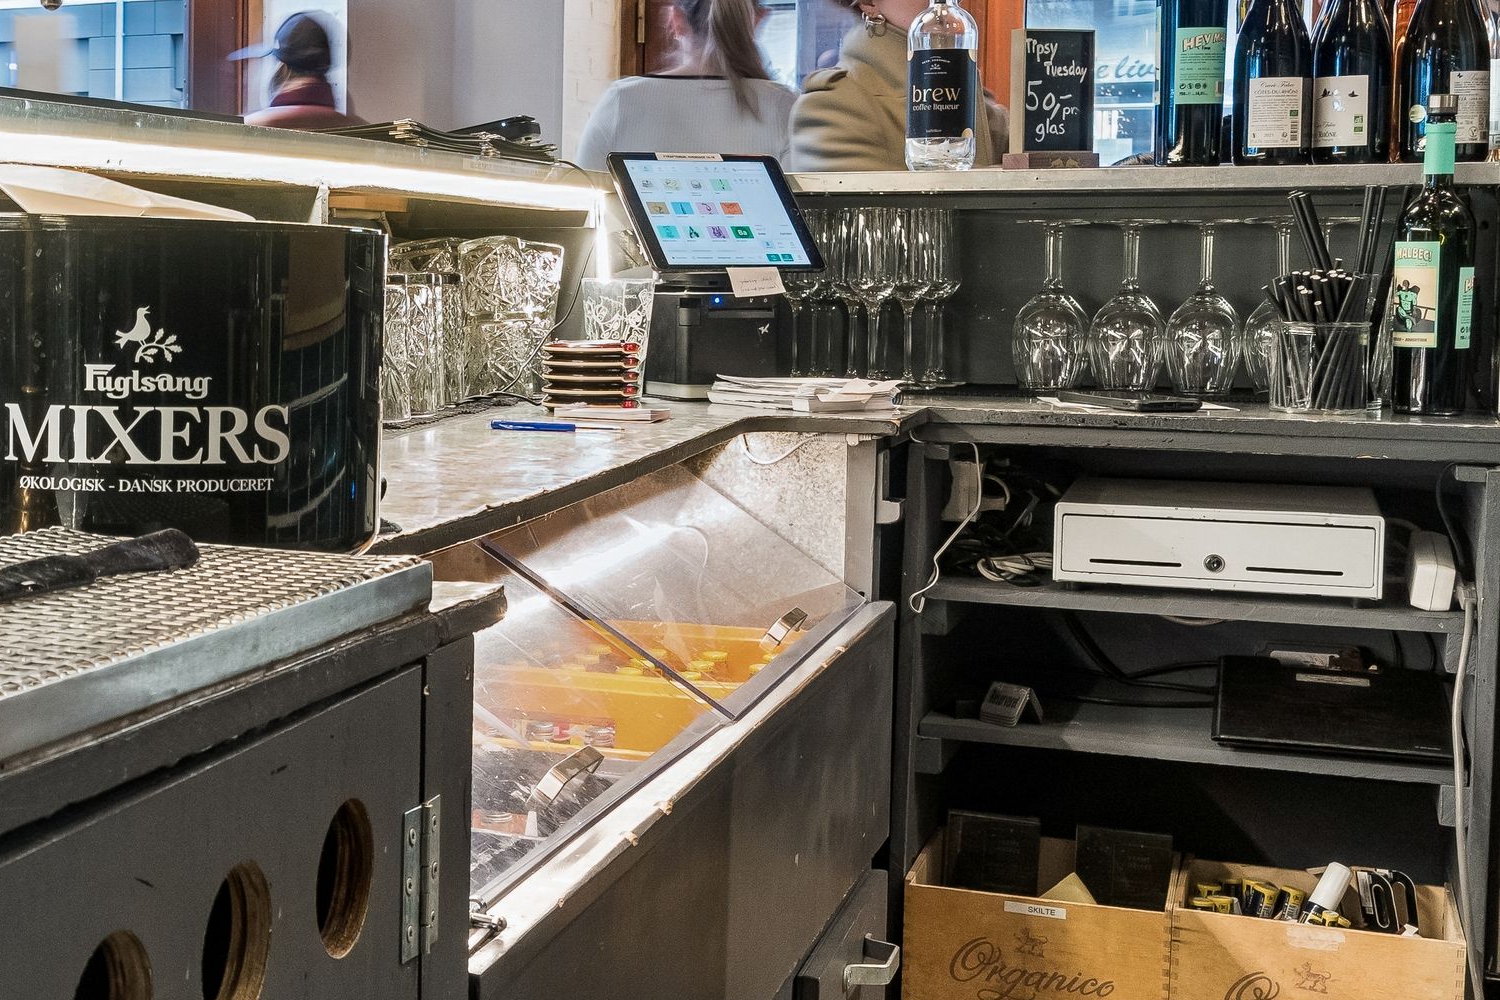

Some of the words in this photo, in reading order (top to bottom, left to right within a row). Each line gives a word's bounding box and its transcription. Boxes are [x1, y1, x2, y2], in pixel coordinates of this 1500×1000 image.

[1043, 59, 1087, 83] Tuesday
[912, 84, 961, 103] brew
[912, 103, 932, 111] coffee
[933, 103, 960, 112] liqueur
[1035, 118, 1065, 142] glas
[84, 364, 213, 399] Fuglsang
[4, 402, 290, 465] MIXERS
[19, 475, 106, 493] ØKOLOGISK
[118, 478, 173, 493] DANSK
[176, 478, 275, 493] PRODUCERET
[1027, 905, 1056, 917] SKILTE
